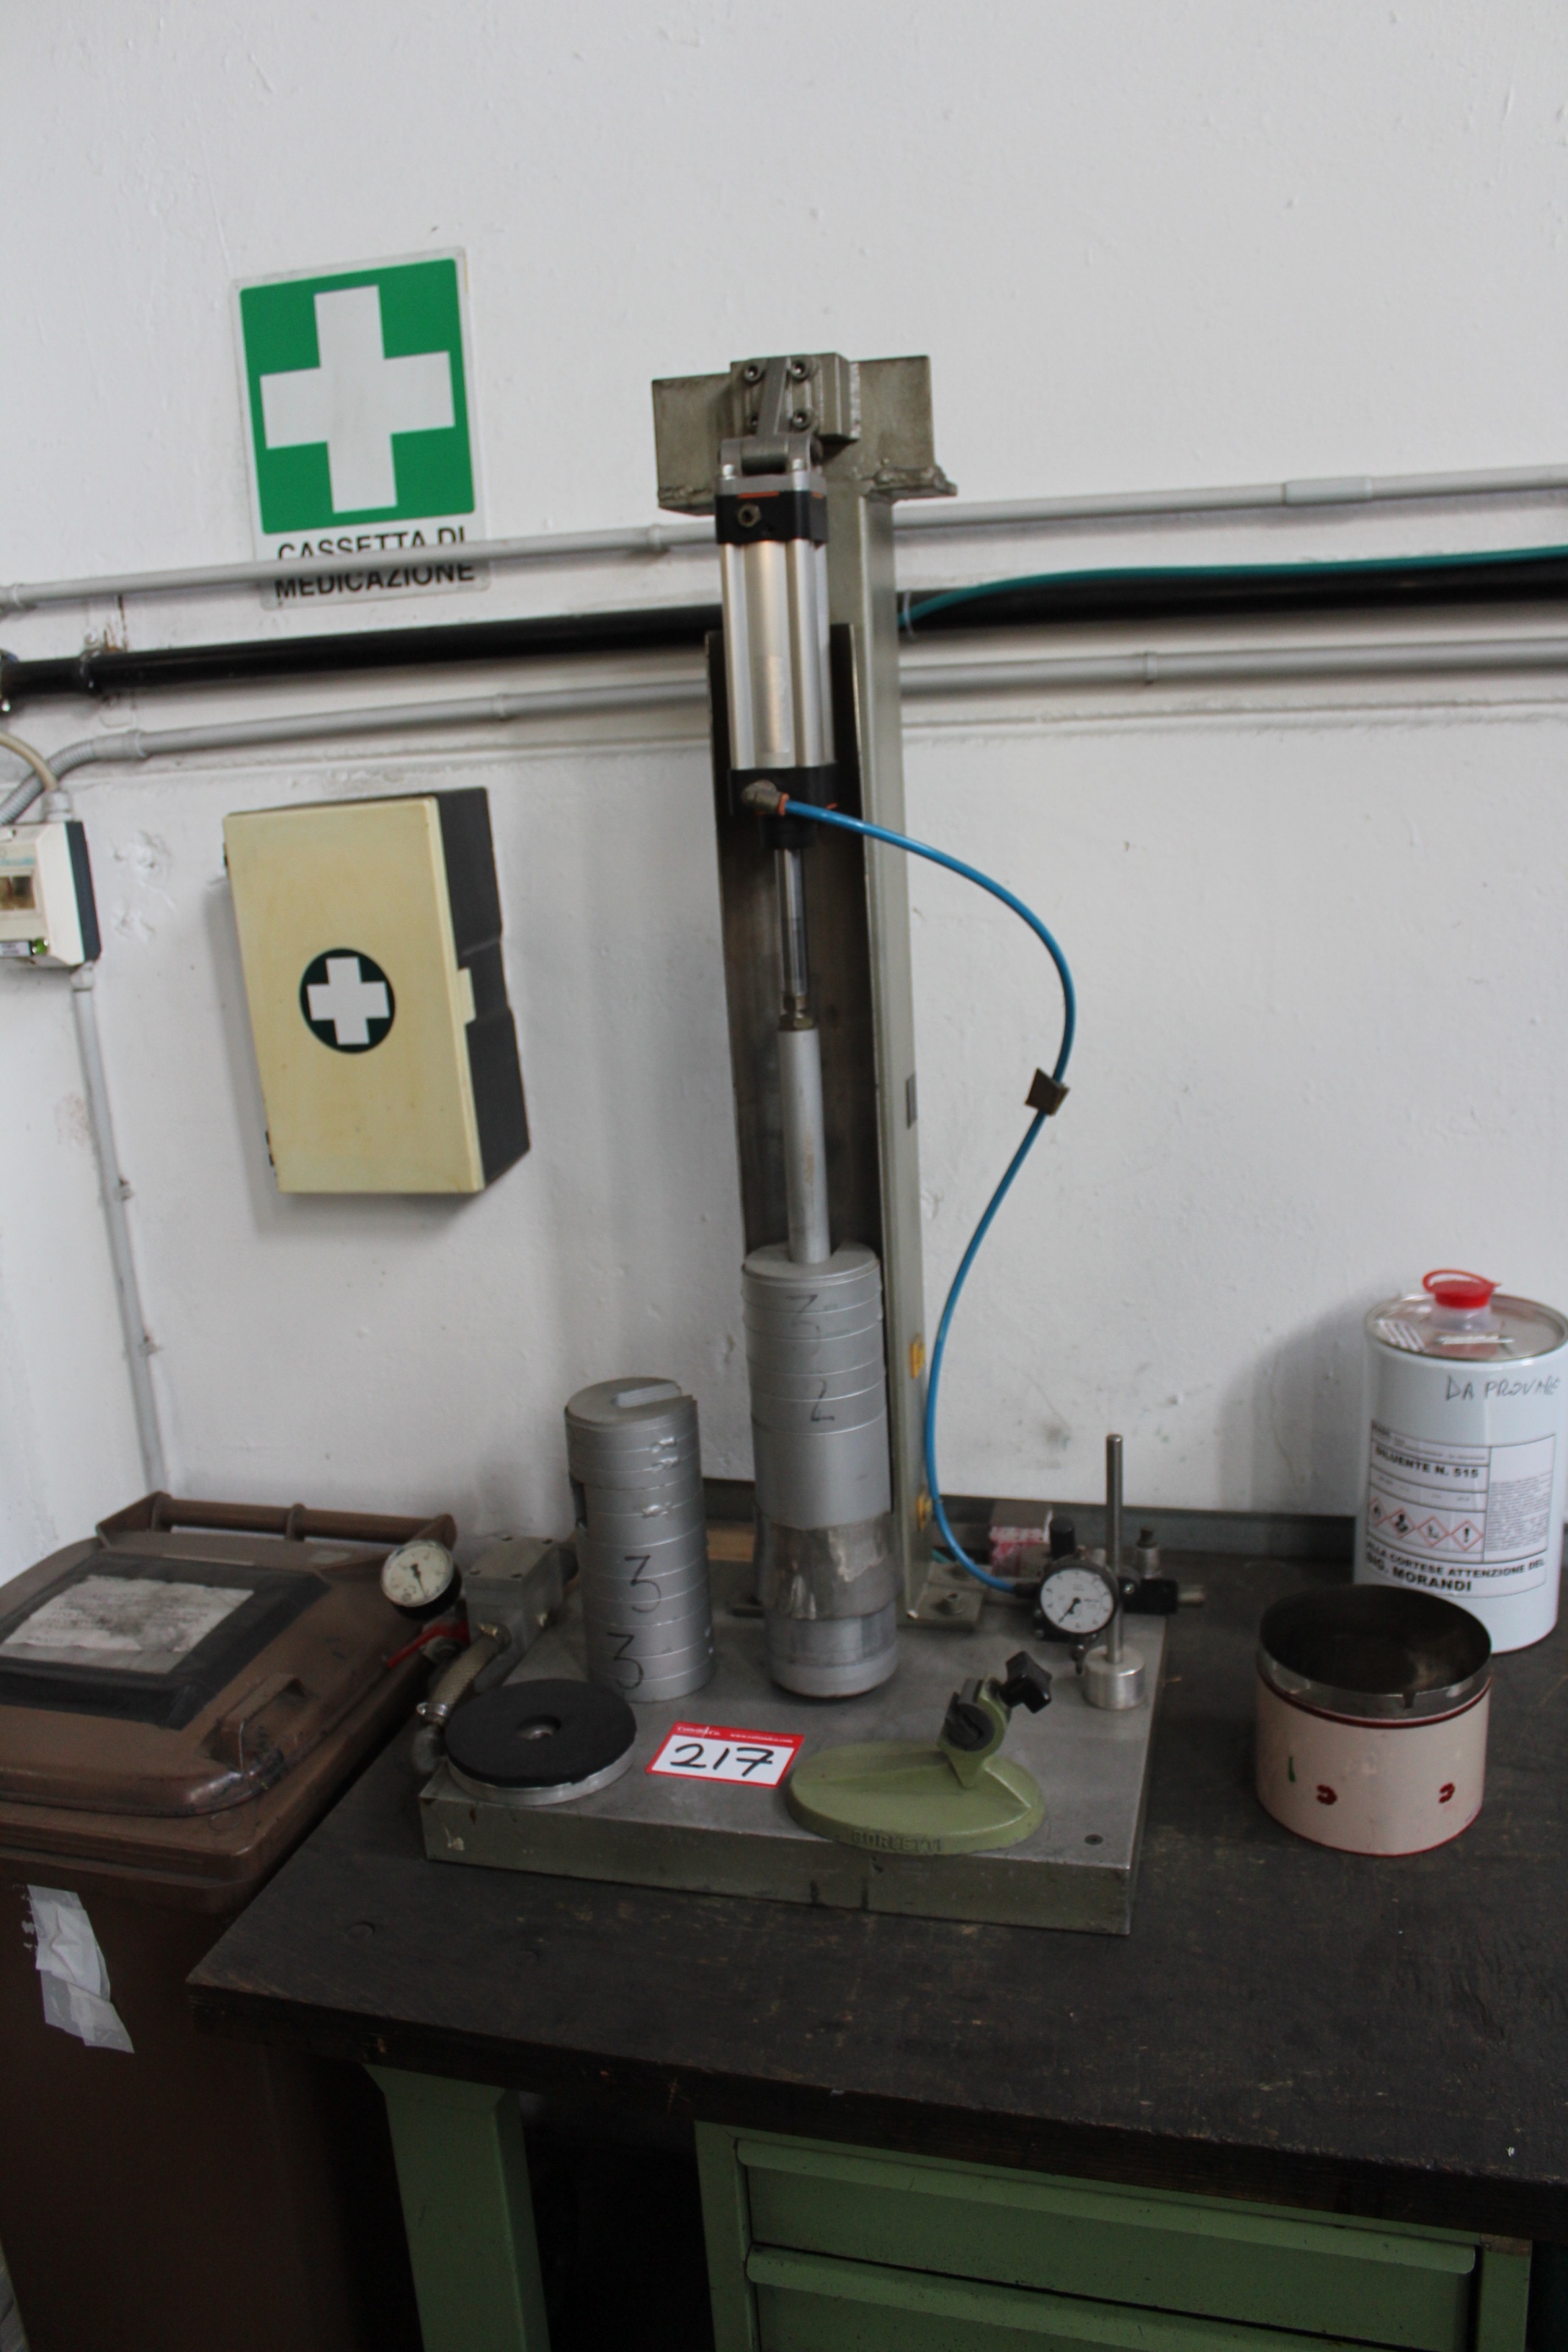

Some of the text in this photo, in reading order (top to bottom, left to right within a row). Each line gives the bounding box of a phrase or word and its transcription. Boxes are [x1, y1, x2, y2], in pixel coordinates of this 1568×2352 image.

[437, 525, 466, 545] DI
[274, 563, 475, 598] MEDICAZIONE
[1446, 1375, 1474, 1401] DA
[1454, 1467, 1479, 1478] 515
[1388, 1552, 1443, 1575] CORTESE
[1448, 1564, 1525, 1579] ATTENZIONE
[1528, 1559, 1545, 1571] DEL
[1392, 1566, 1471, 1592] MORANDI
[670, 1743, 774, 1777] 217
